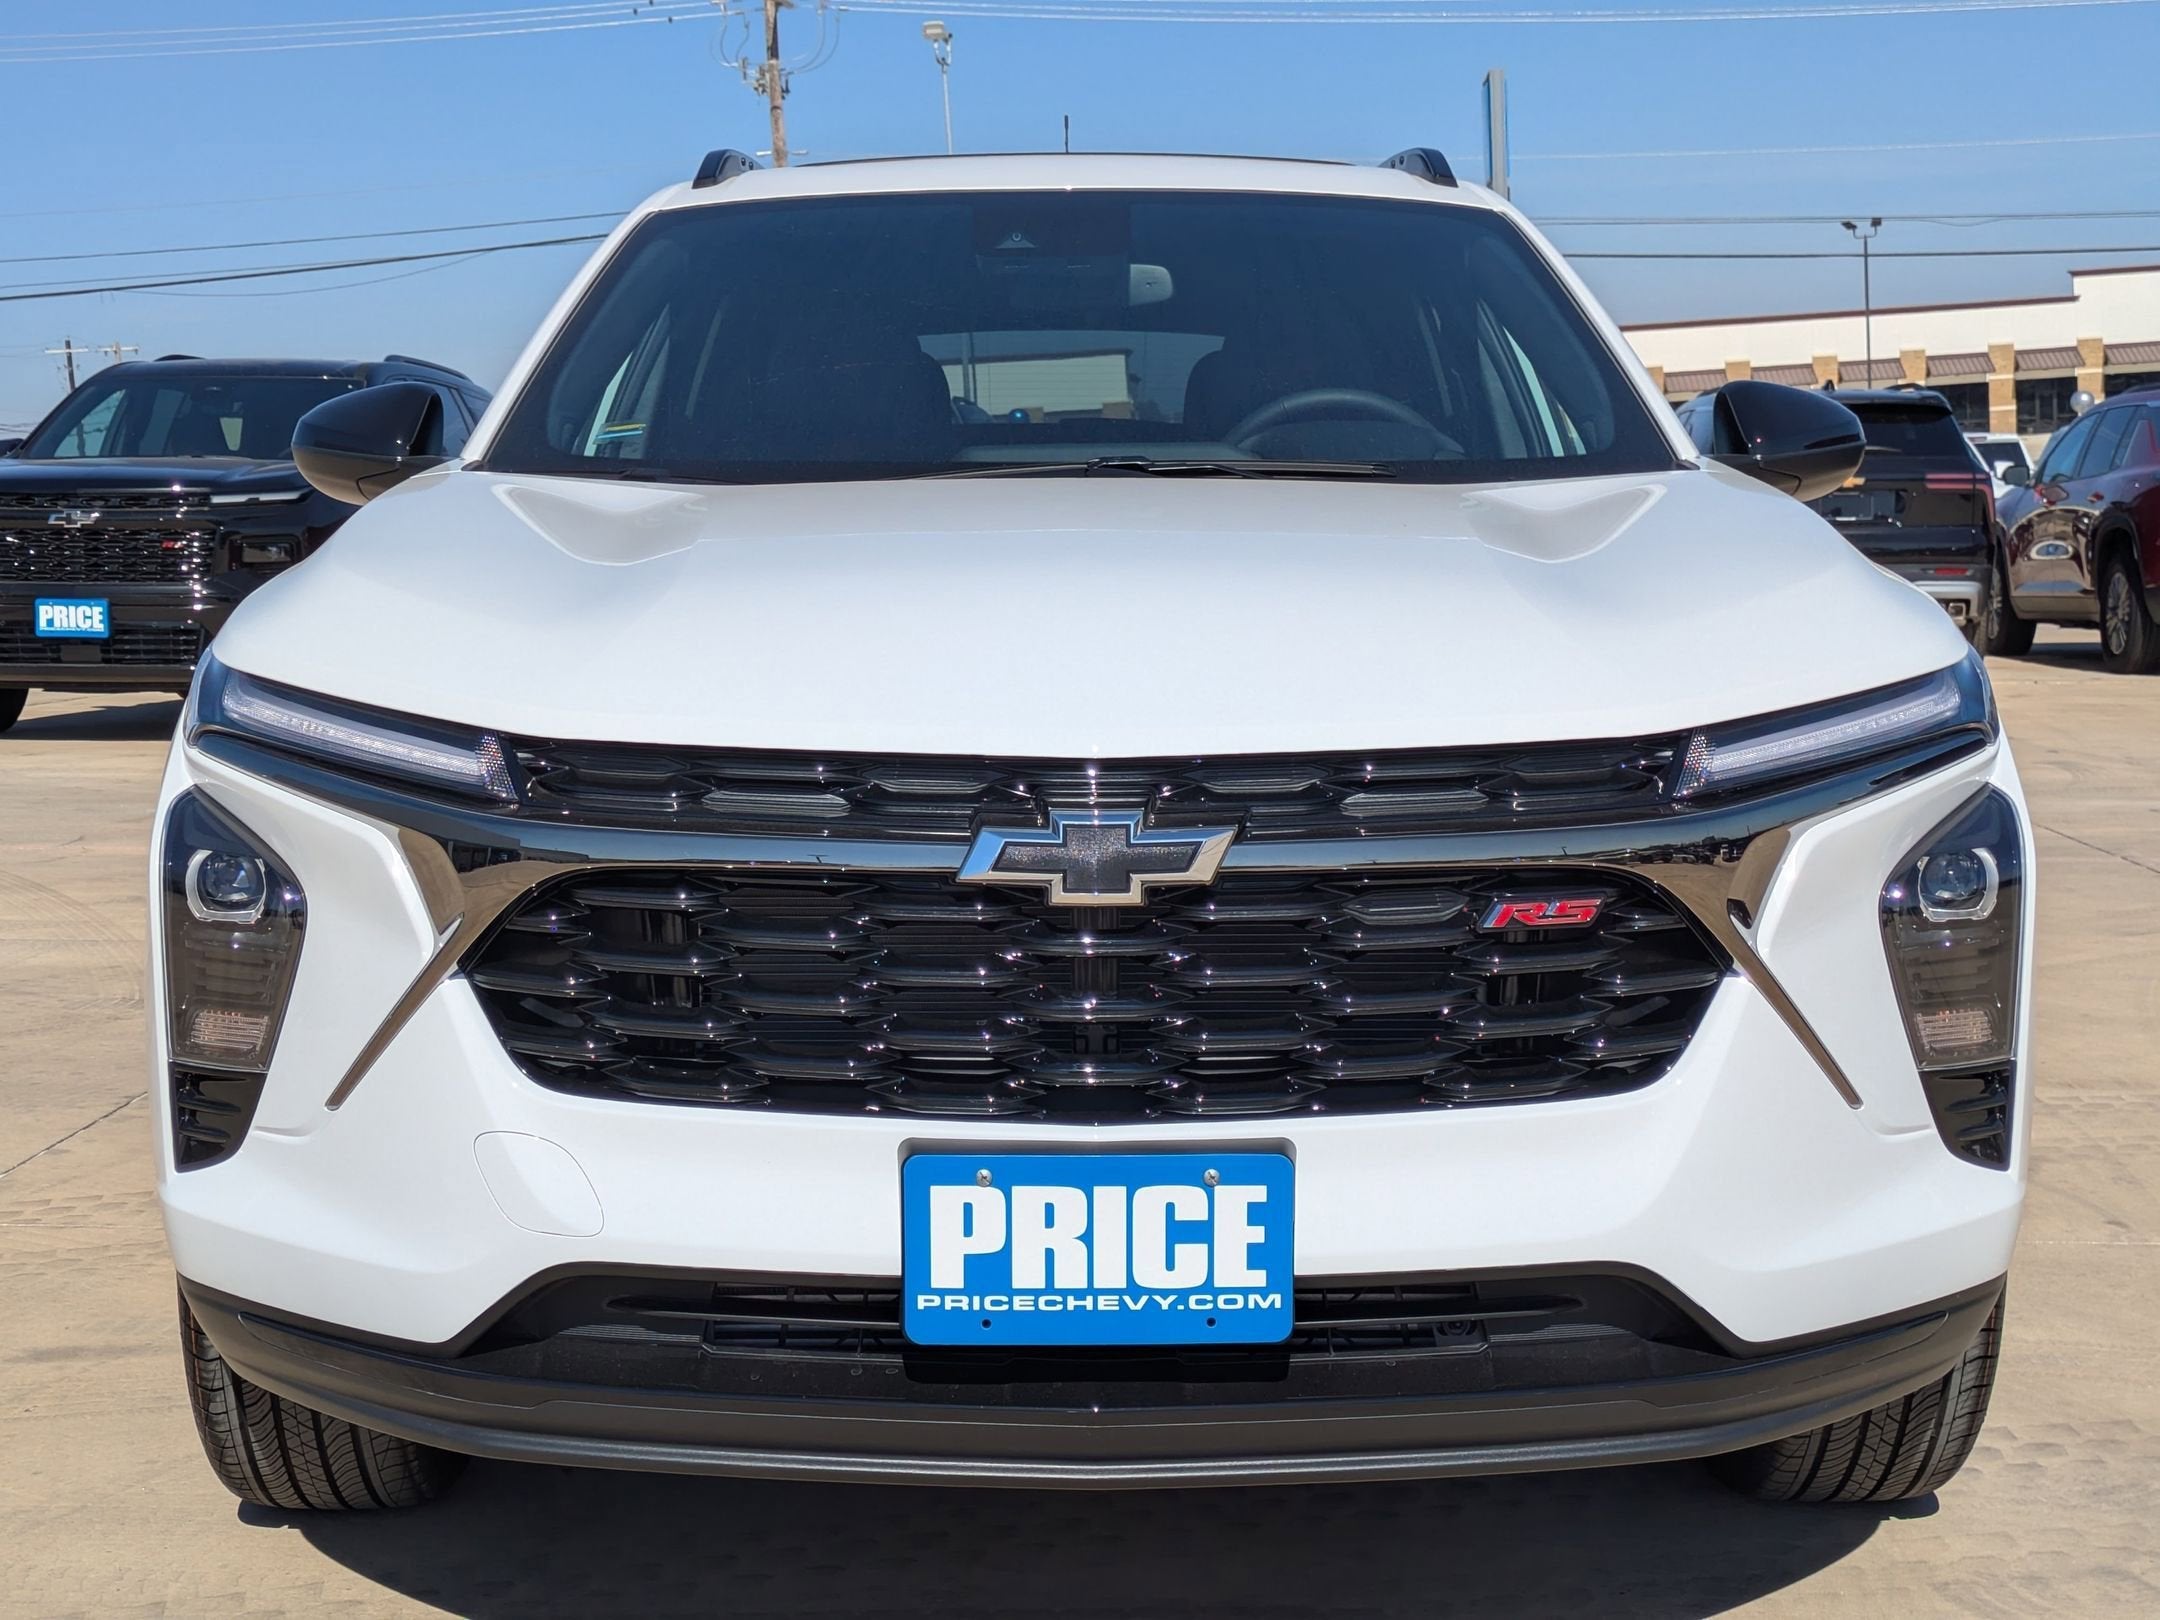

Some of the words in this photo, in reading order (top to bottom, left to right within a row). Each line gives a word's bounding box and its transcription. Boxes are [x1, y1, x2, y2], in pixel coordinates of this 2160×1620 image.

[38, 605, 104, 629] PRICE
[1483, 899, 1601, 928] RS
[929, 1185, 1268, 1290] PRICE
[917, 1293, 1282, 1312] PRICECHEVY.COM
